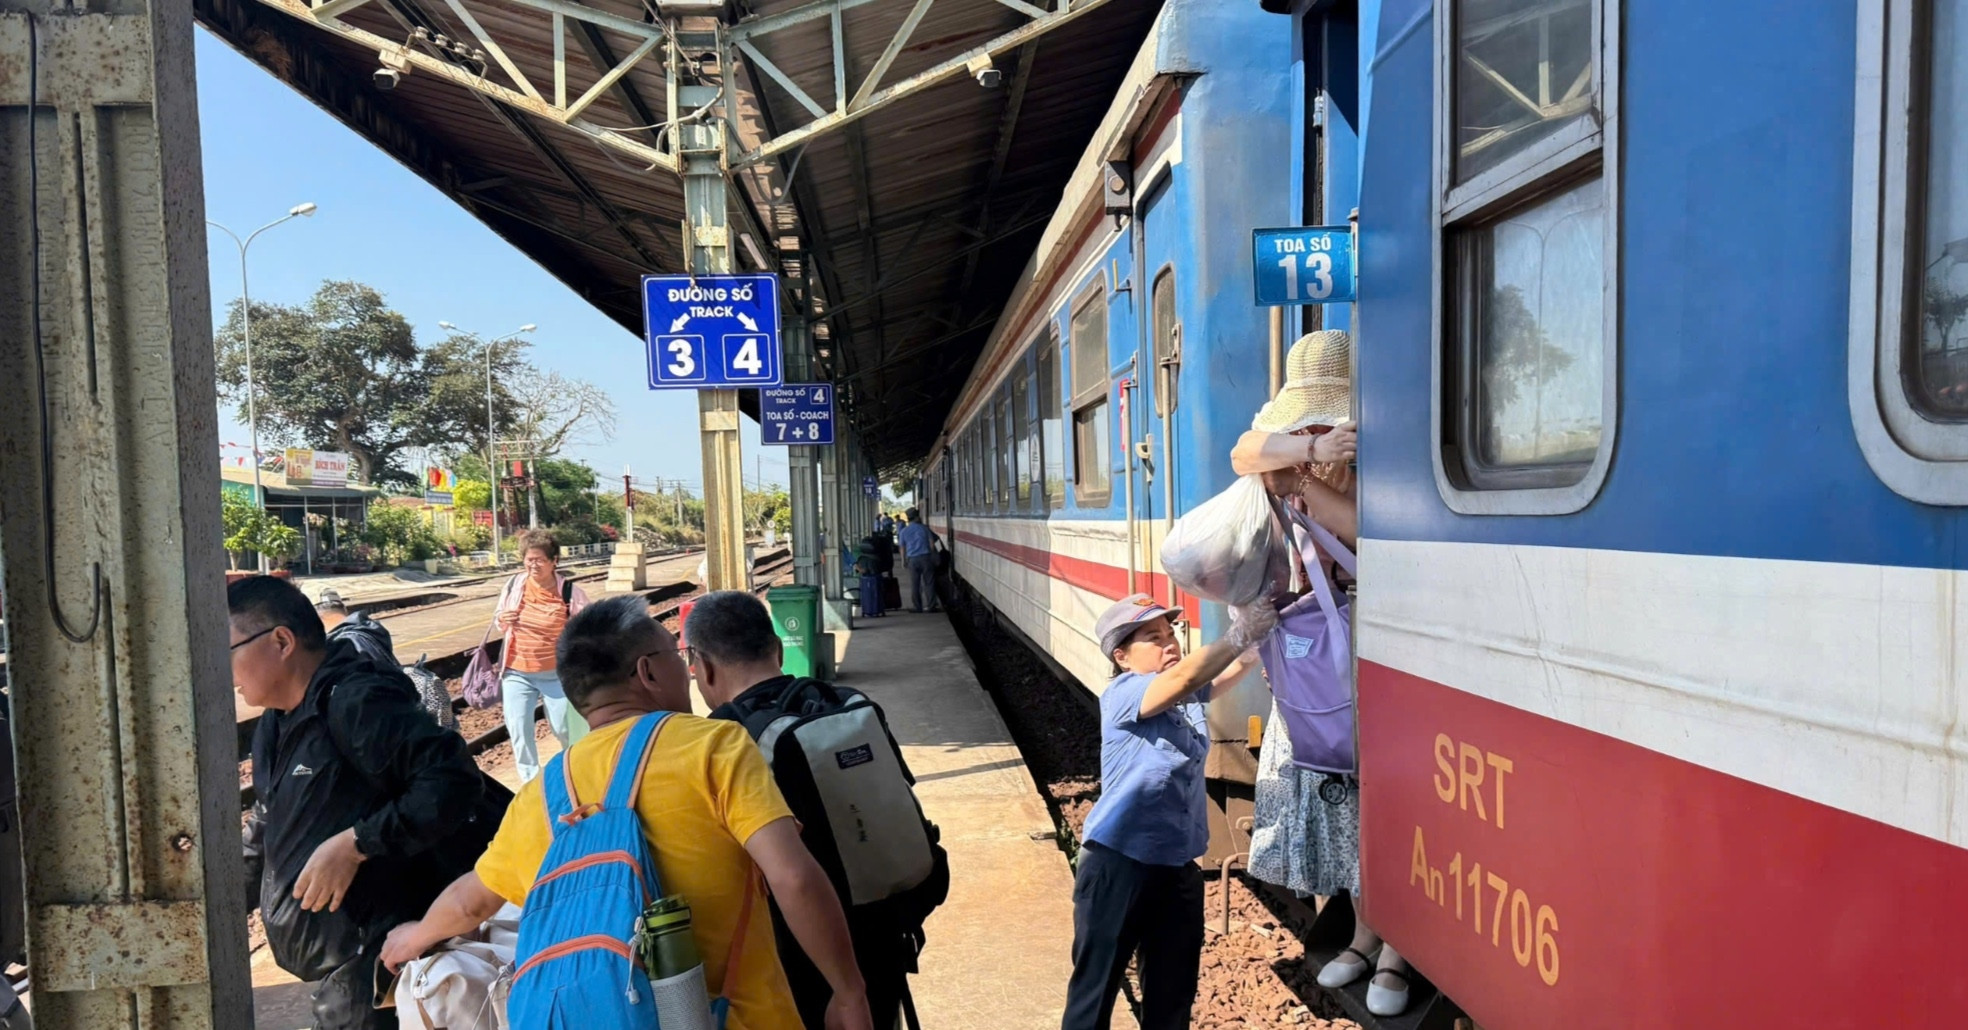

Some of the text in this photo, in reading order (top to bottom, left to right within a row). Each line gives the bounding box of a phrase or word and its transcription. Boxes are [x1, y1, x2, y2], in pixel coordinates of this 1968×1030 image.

[1274, 232, 1332, 253] TOA SỐ
[1278, 252, 1333, 300] 13
[668, 283, 753, 302] ĐƯỜNG SỐ
[689, 306, 734, 318] TRACK
[667, 338, 763, 377] 3 4
[766, 387, 806, 397] ĐƯỜNG SỐ
[813, 388, 825, 403] 4
[766, 412, 782, 420] TOA
[783, 408, 794, 420] SỐ
[800, 411, 829, 420] COACH
[775, 422, 819, 441] 7 + 8
[1434, 733, 1513, 829] SRT
